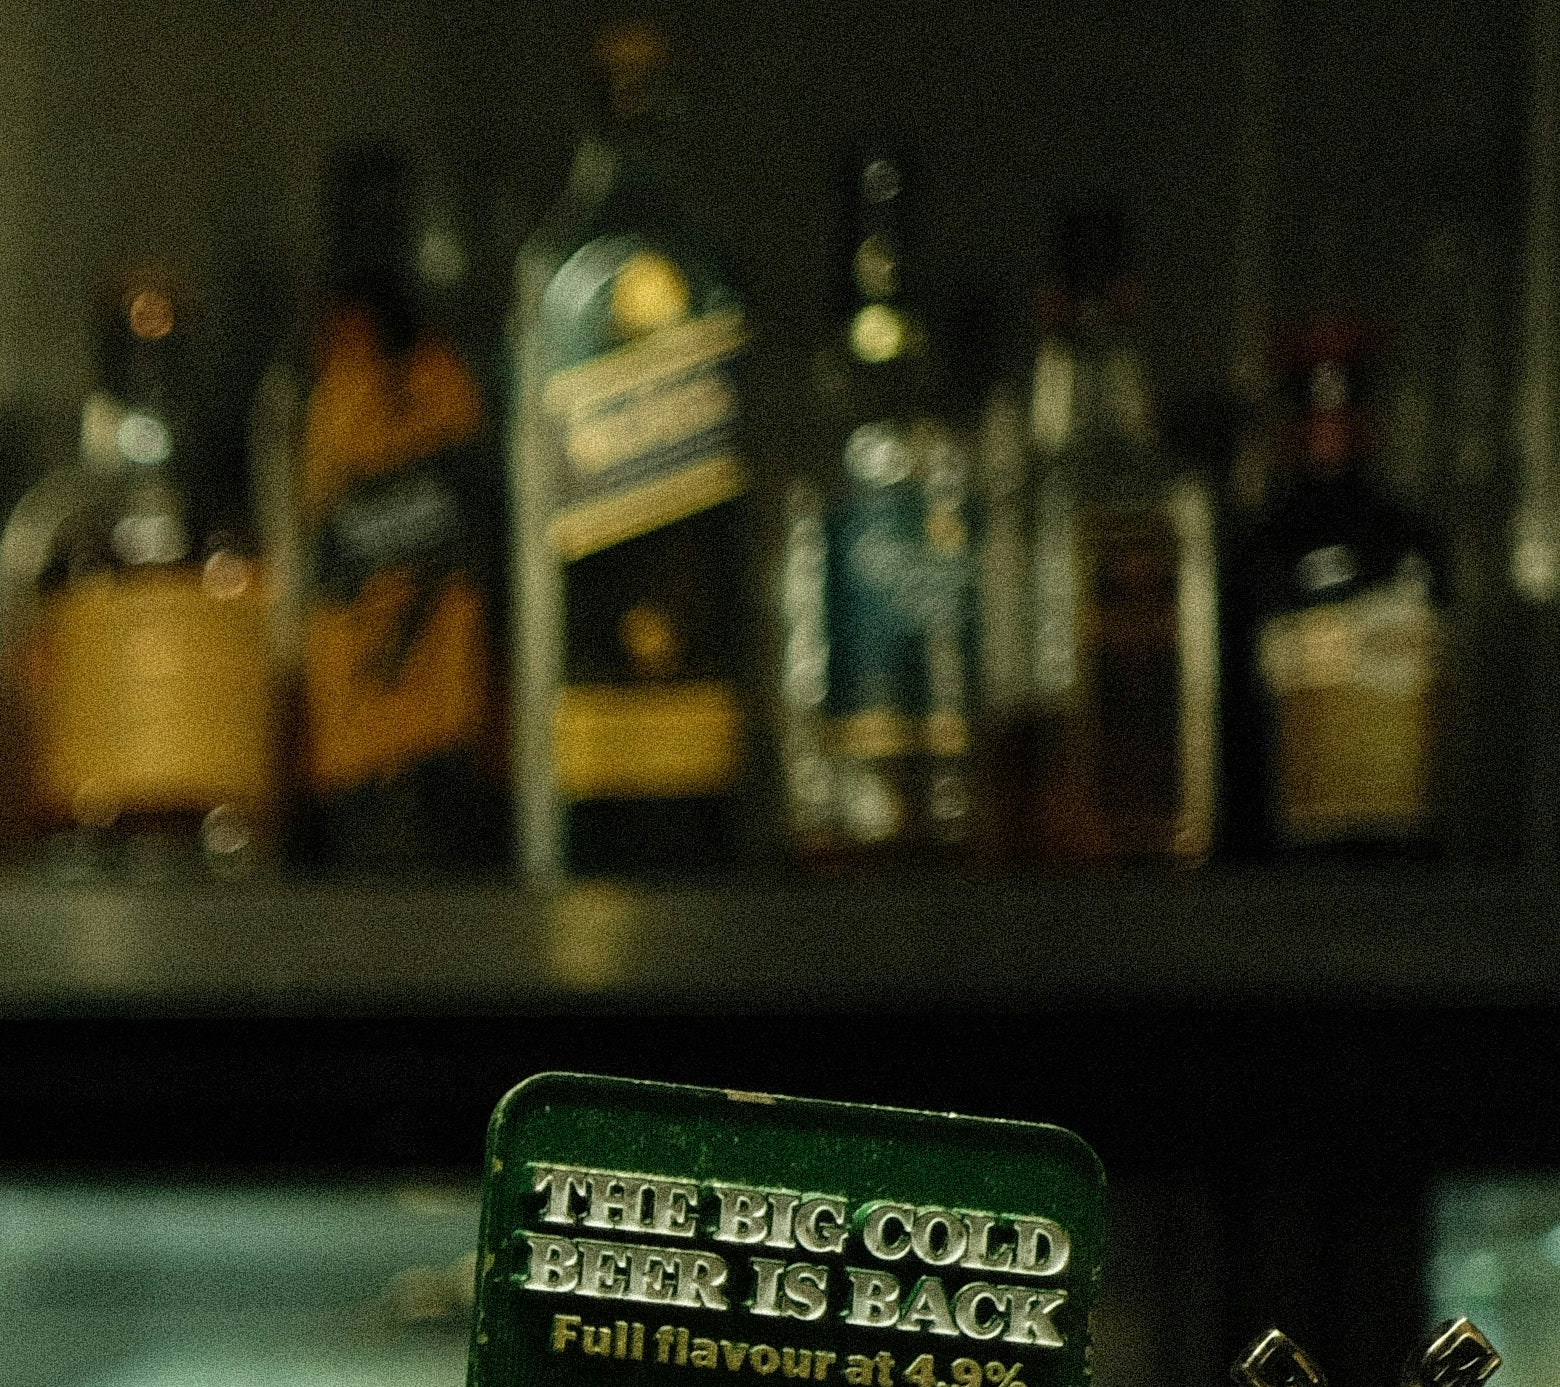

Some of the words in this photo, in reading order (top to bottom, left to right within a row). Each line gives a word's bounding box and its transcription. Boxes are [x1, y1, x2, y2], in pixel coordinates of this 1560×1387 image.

[529, 1162, 700, 1238] THE
[712, 1180, 848, 1254] BIG
[861, 1201, 1072, 1277] COLD
[521, 1232, 729, 1310] BEER
[750, 1257, 828, 1321] IS
[845, 1268, 1069, 1347] BACK
[552, 1314, 645, 1362] Full
[654, 1324, 835, 1382] flavour
[845, 1351, 894, 1387] at
